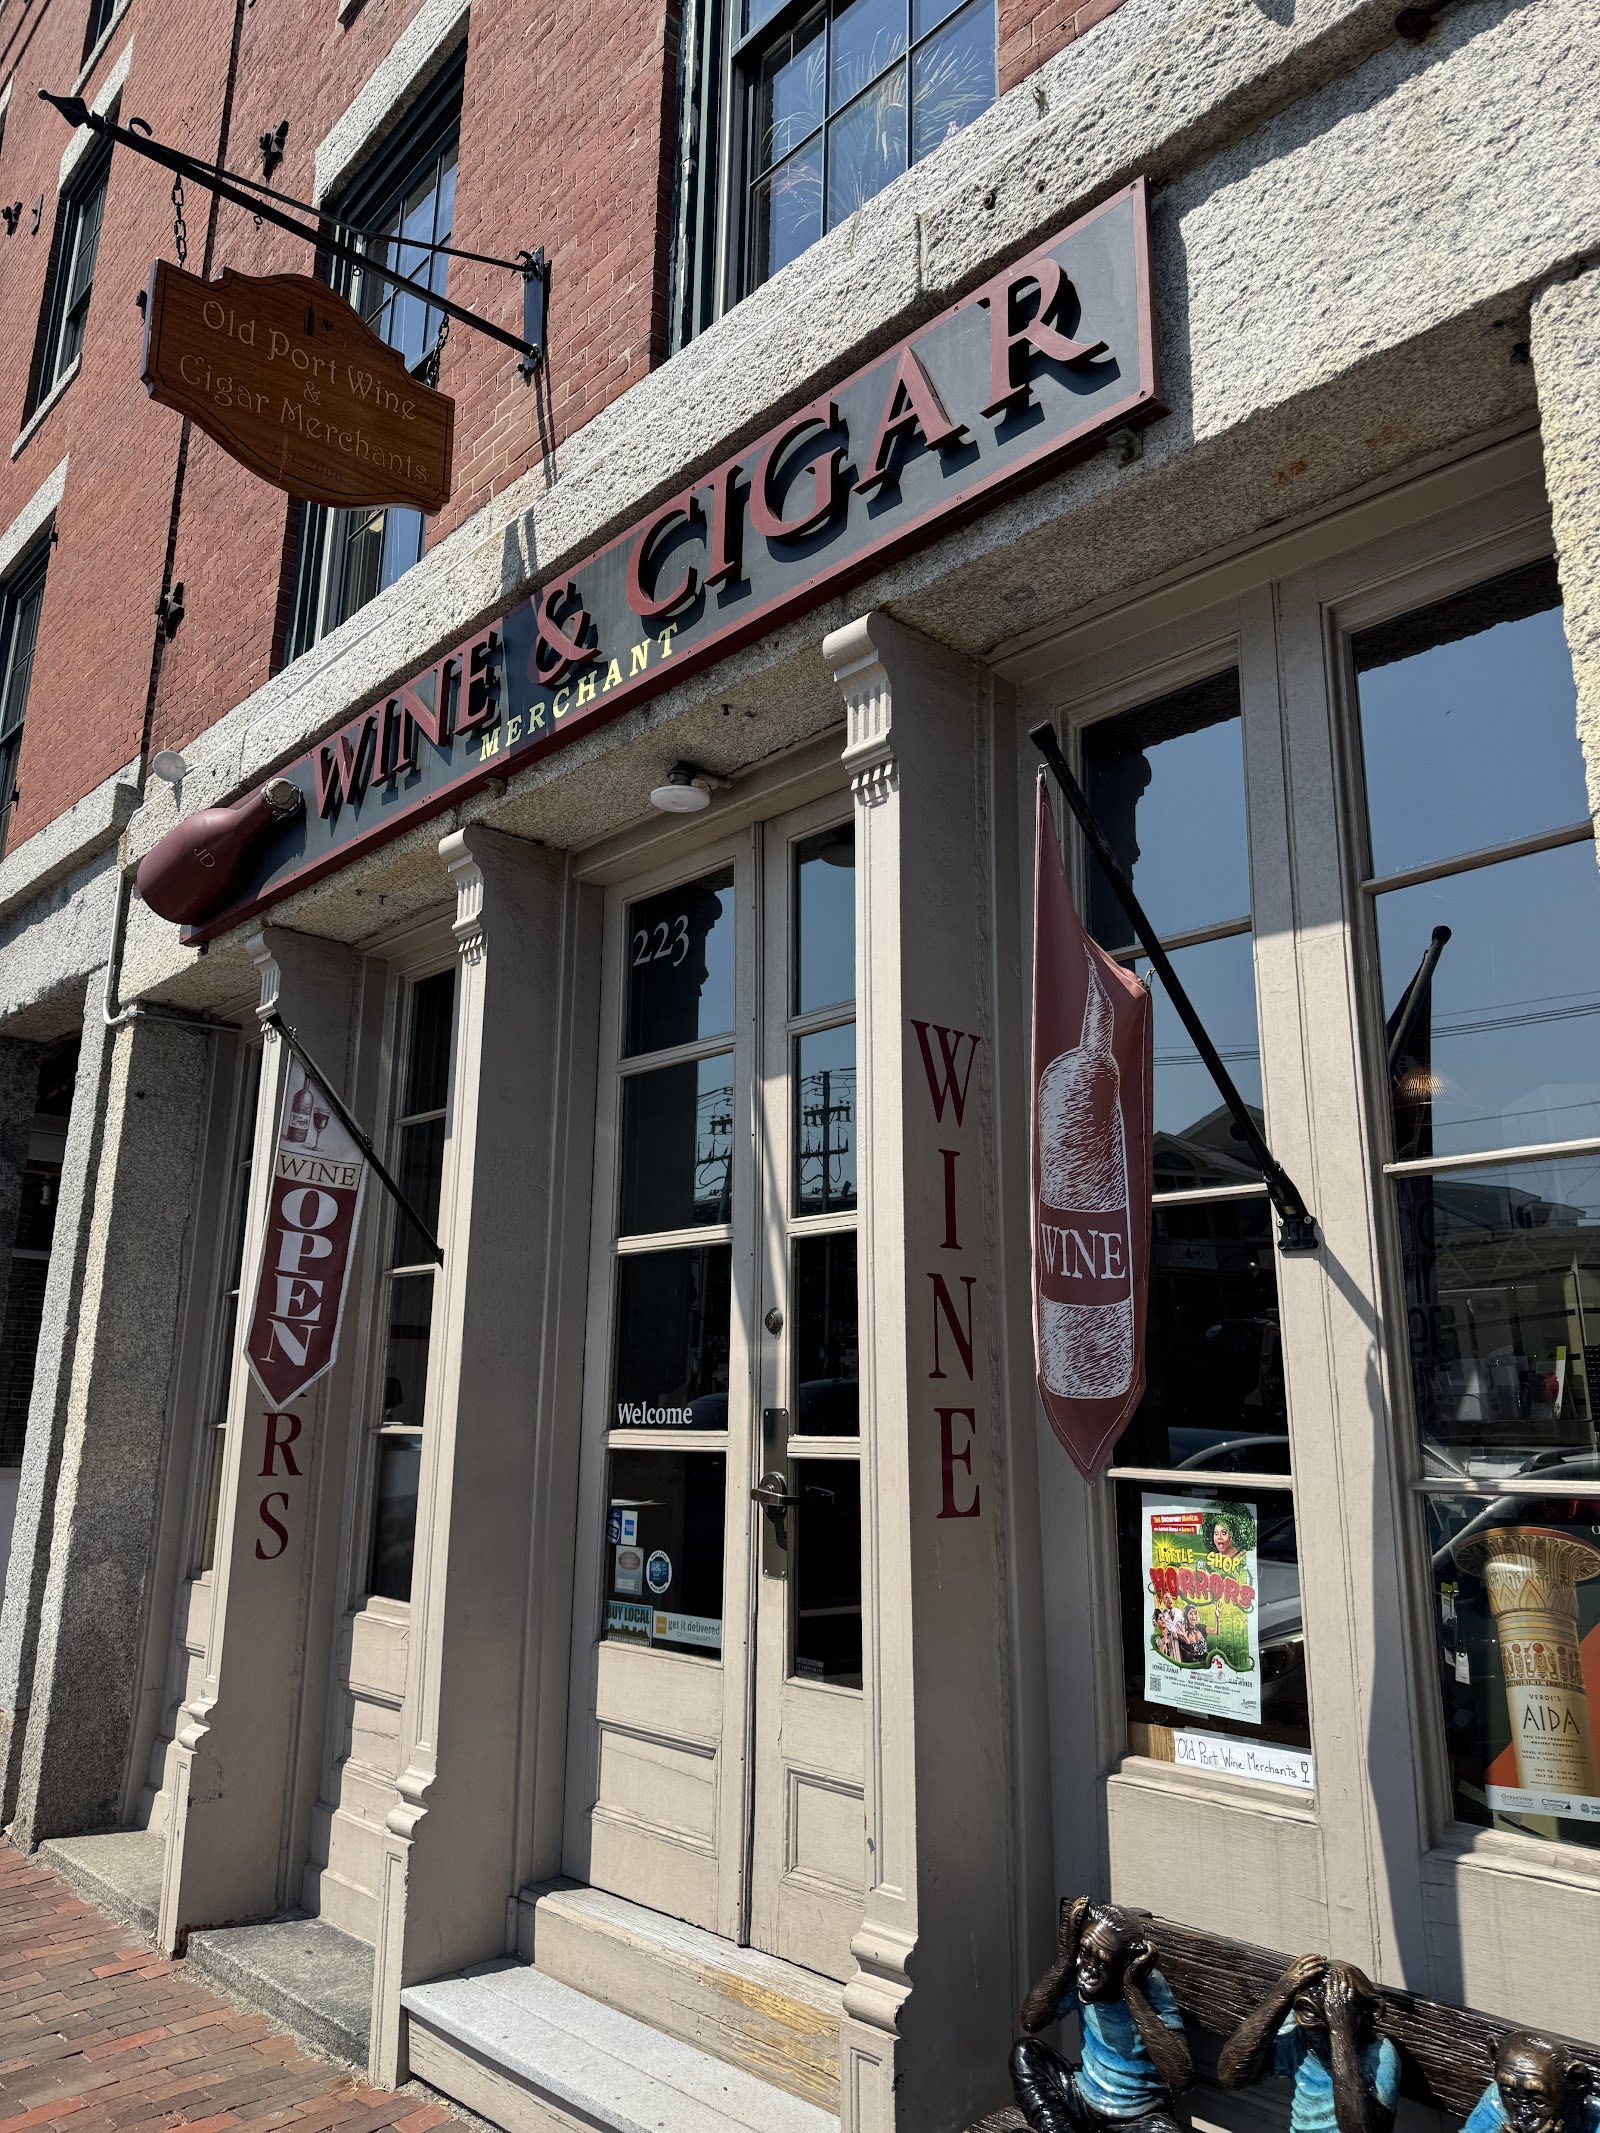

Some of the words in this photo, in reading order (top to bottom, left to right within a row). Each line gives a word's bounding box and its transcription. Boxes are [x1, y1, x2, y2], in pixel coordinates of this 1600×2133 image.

[203, 301, 255, 346] Old
[267, 328, 336, 384] Port
[348, 365, 416, 420] Wine
[303, 381, 321, 405] &
[180, 355, 269, 414] Cigar
[279, 398, 427, 484] Merchants
[312, 632, 498, 819] WINE
[528, 581, 602, 686] &
[625, 258, 1109, 617] CIGAR
[480, 623, 679, 762] MERCHANT
[633, 915, 689, 967] 223
[280, 1154, 356, 1187] WINE
[910, 1019, 981, 1518] WINE
[1041, 1223, 1126, 1279] WINE
[260, 1188, 338, 1366] OPEN
[617, 1401, 693, 1424] Welcome
[1206, 1551, 1240, 1573] SHOP
[1149, 1566, 1255, 1608] HORRORS
[607, 1604, 624, 1620] BUY
[625, 1606, 650, 1624] LOCAL
[668, 1619, 679, 1631] get
[681, 1620, 686, 1631] it
[688, 1621, 720, 1635] delivered
[1529, 1693, 1561, 1702] VERDI'S
[1523, 1704, 1580, 1734] AIDA
[1177, 1738, 1196, 1761] Old
[1199, 1741, 1218, 1765] Port
[1220, 1748, 1245, 1770] Wine
[1247, 1752, 1297, 1778] Merchants
[1501, 1793, 1532, 1802] OceanView
